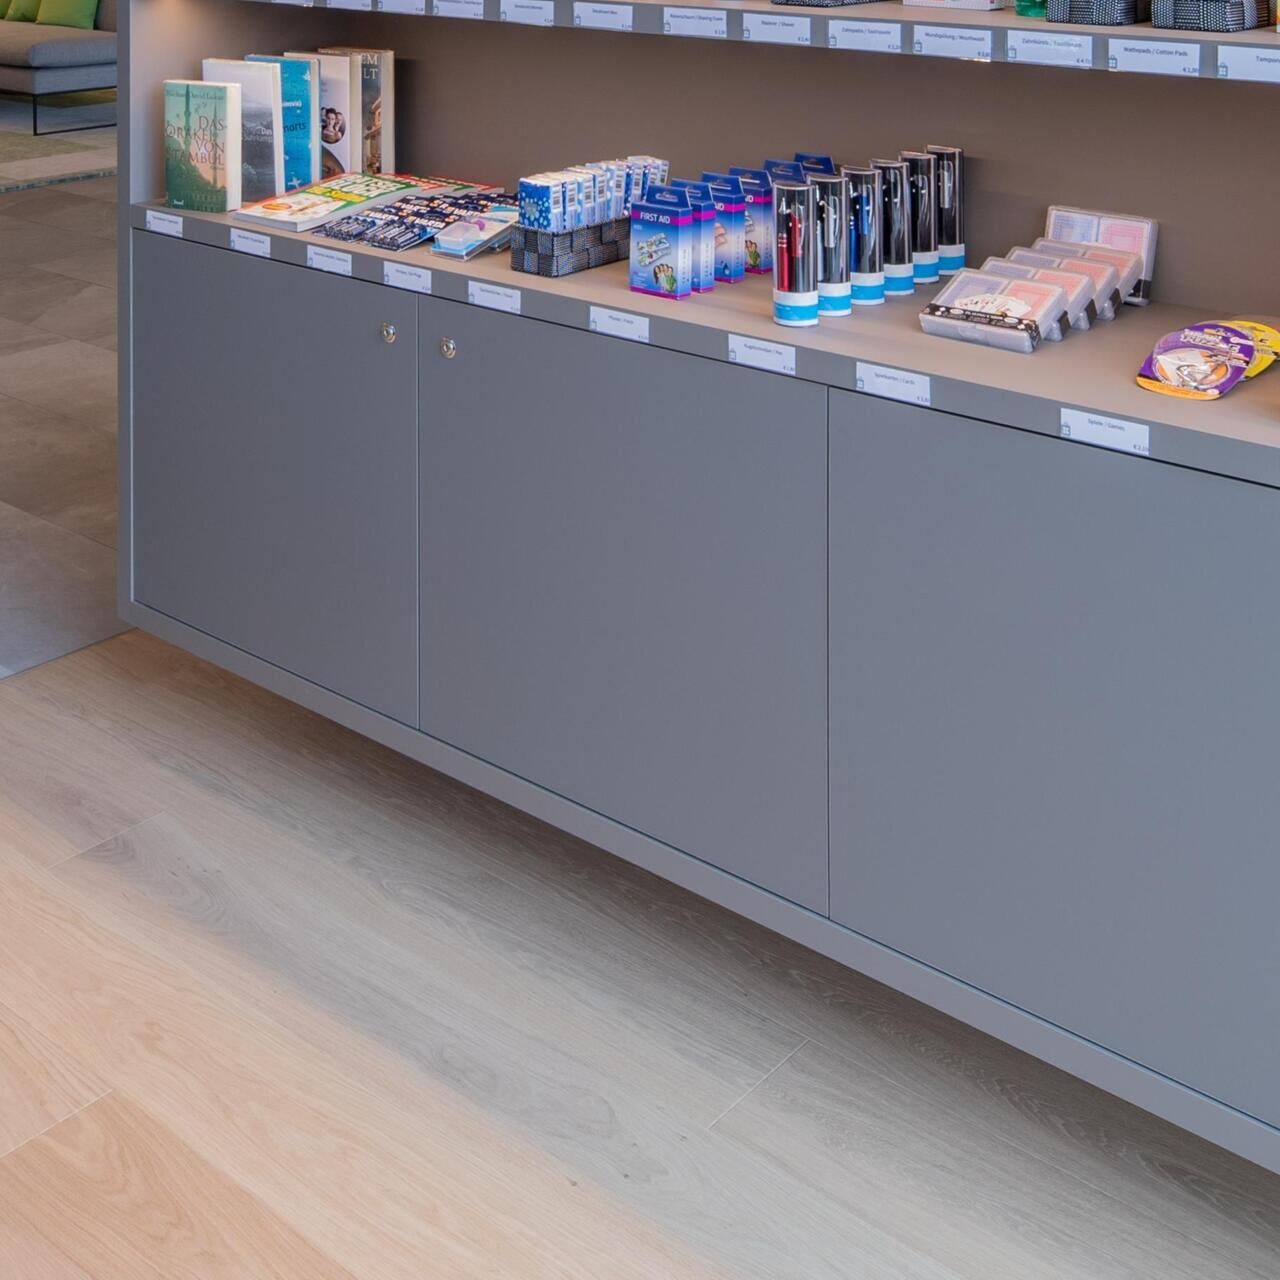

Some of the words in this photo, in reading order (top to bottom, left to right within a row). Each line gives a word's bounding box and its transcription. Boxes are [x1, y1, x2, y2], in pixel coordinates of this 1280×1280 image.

[1175, 49, 1189, 57] Pads
[198, 116, 225, 131] DAS
[195, 139, 224, 154] VON
[639, 211, 657, 224] FIRST
[658, 214, 671, 224] AID
[1107, 422, 1125, 431] Games
